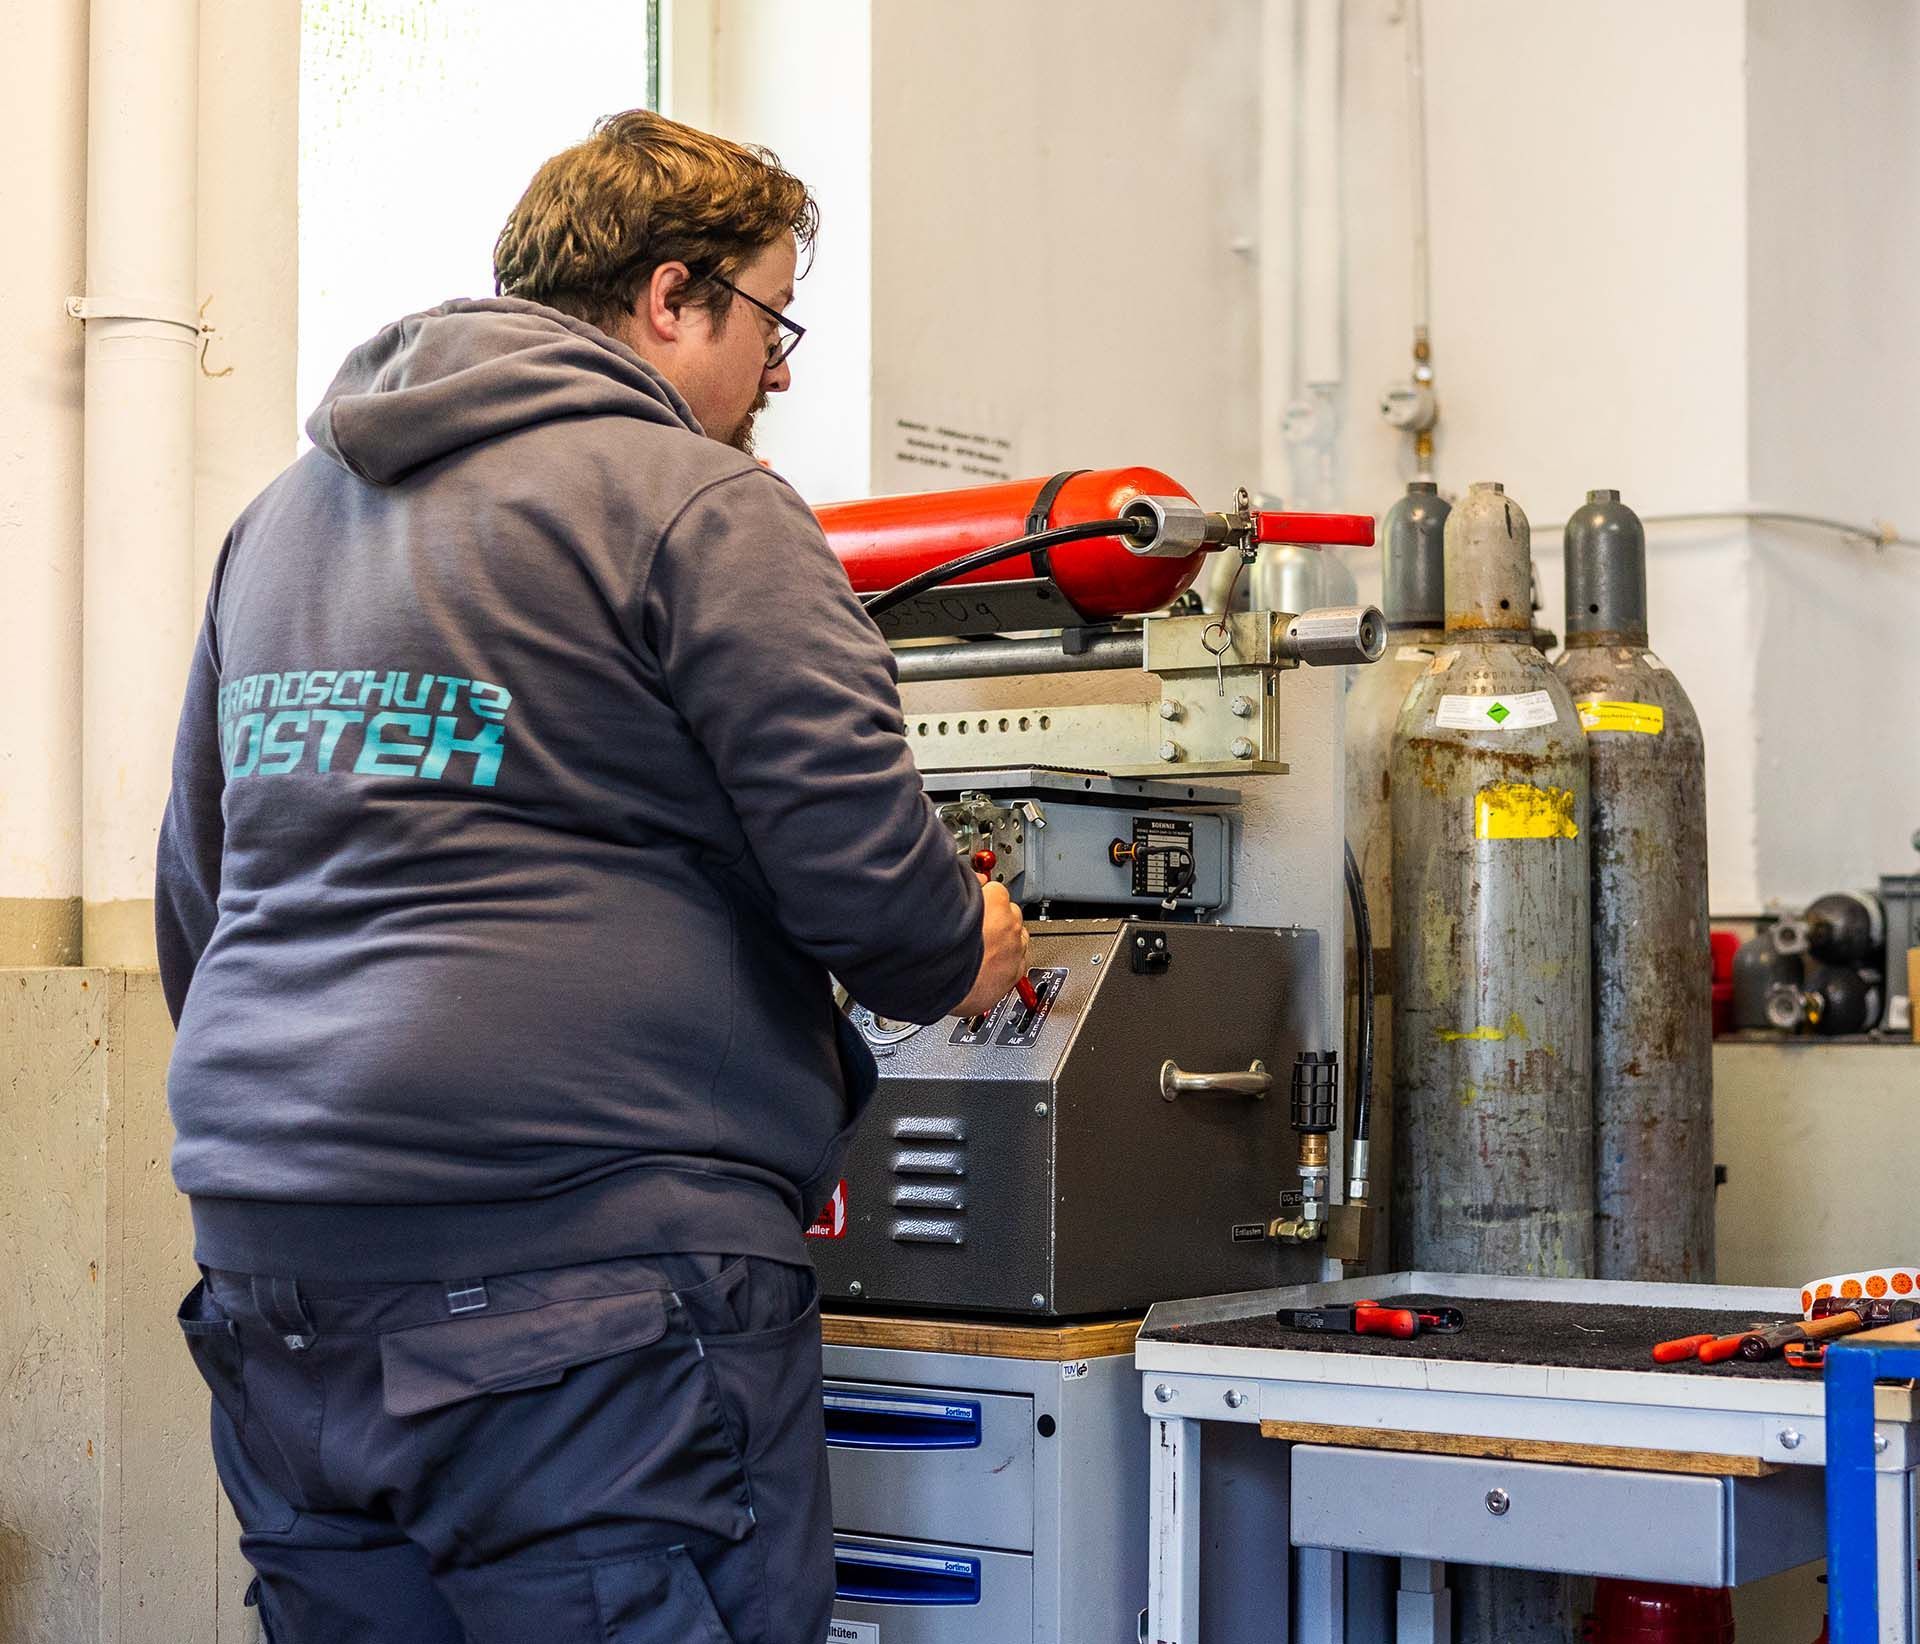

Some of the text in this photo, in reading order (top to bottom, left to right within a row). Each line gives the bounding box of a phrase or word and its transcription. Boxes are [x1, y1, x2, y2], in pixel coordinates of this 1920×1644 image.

[1042, 971, 1054, 979] ZU
[1029, 977, 1062, 1038] ENTLASTEN
[960, 1035, 977, 1043] AUF
[1008, 1037, 1025, 1045] AUF
[945, 1407, 971, 1417] Sortimo
[945, 1561, 970, 1572] Sortimo
[828, 1626, 858, 1639] lltüten
